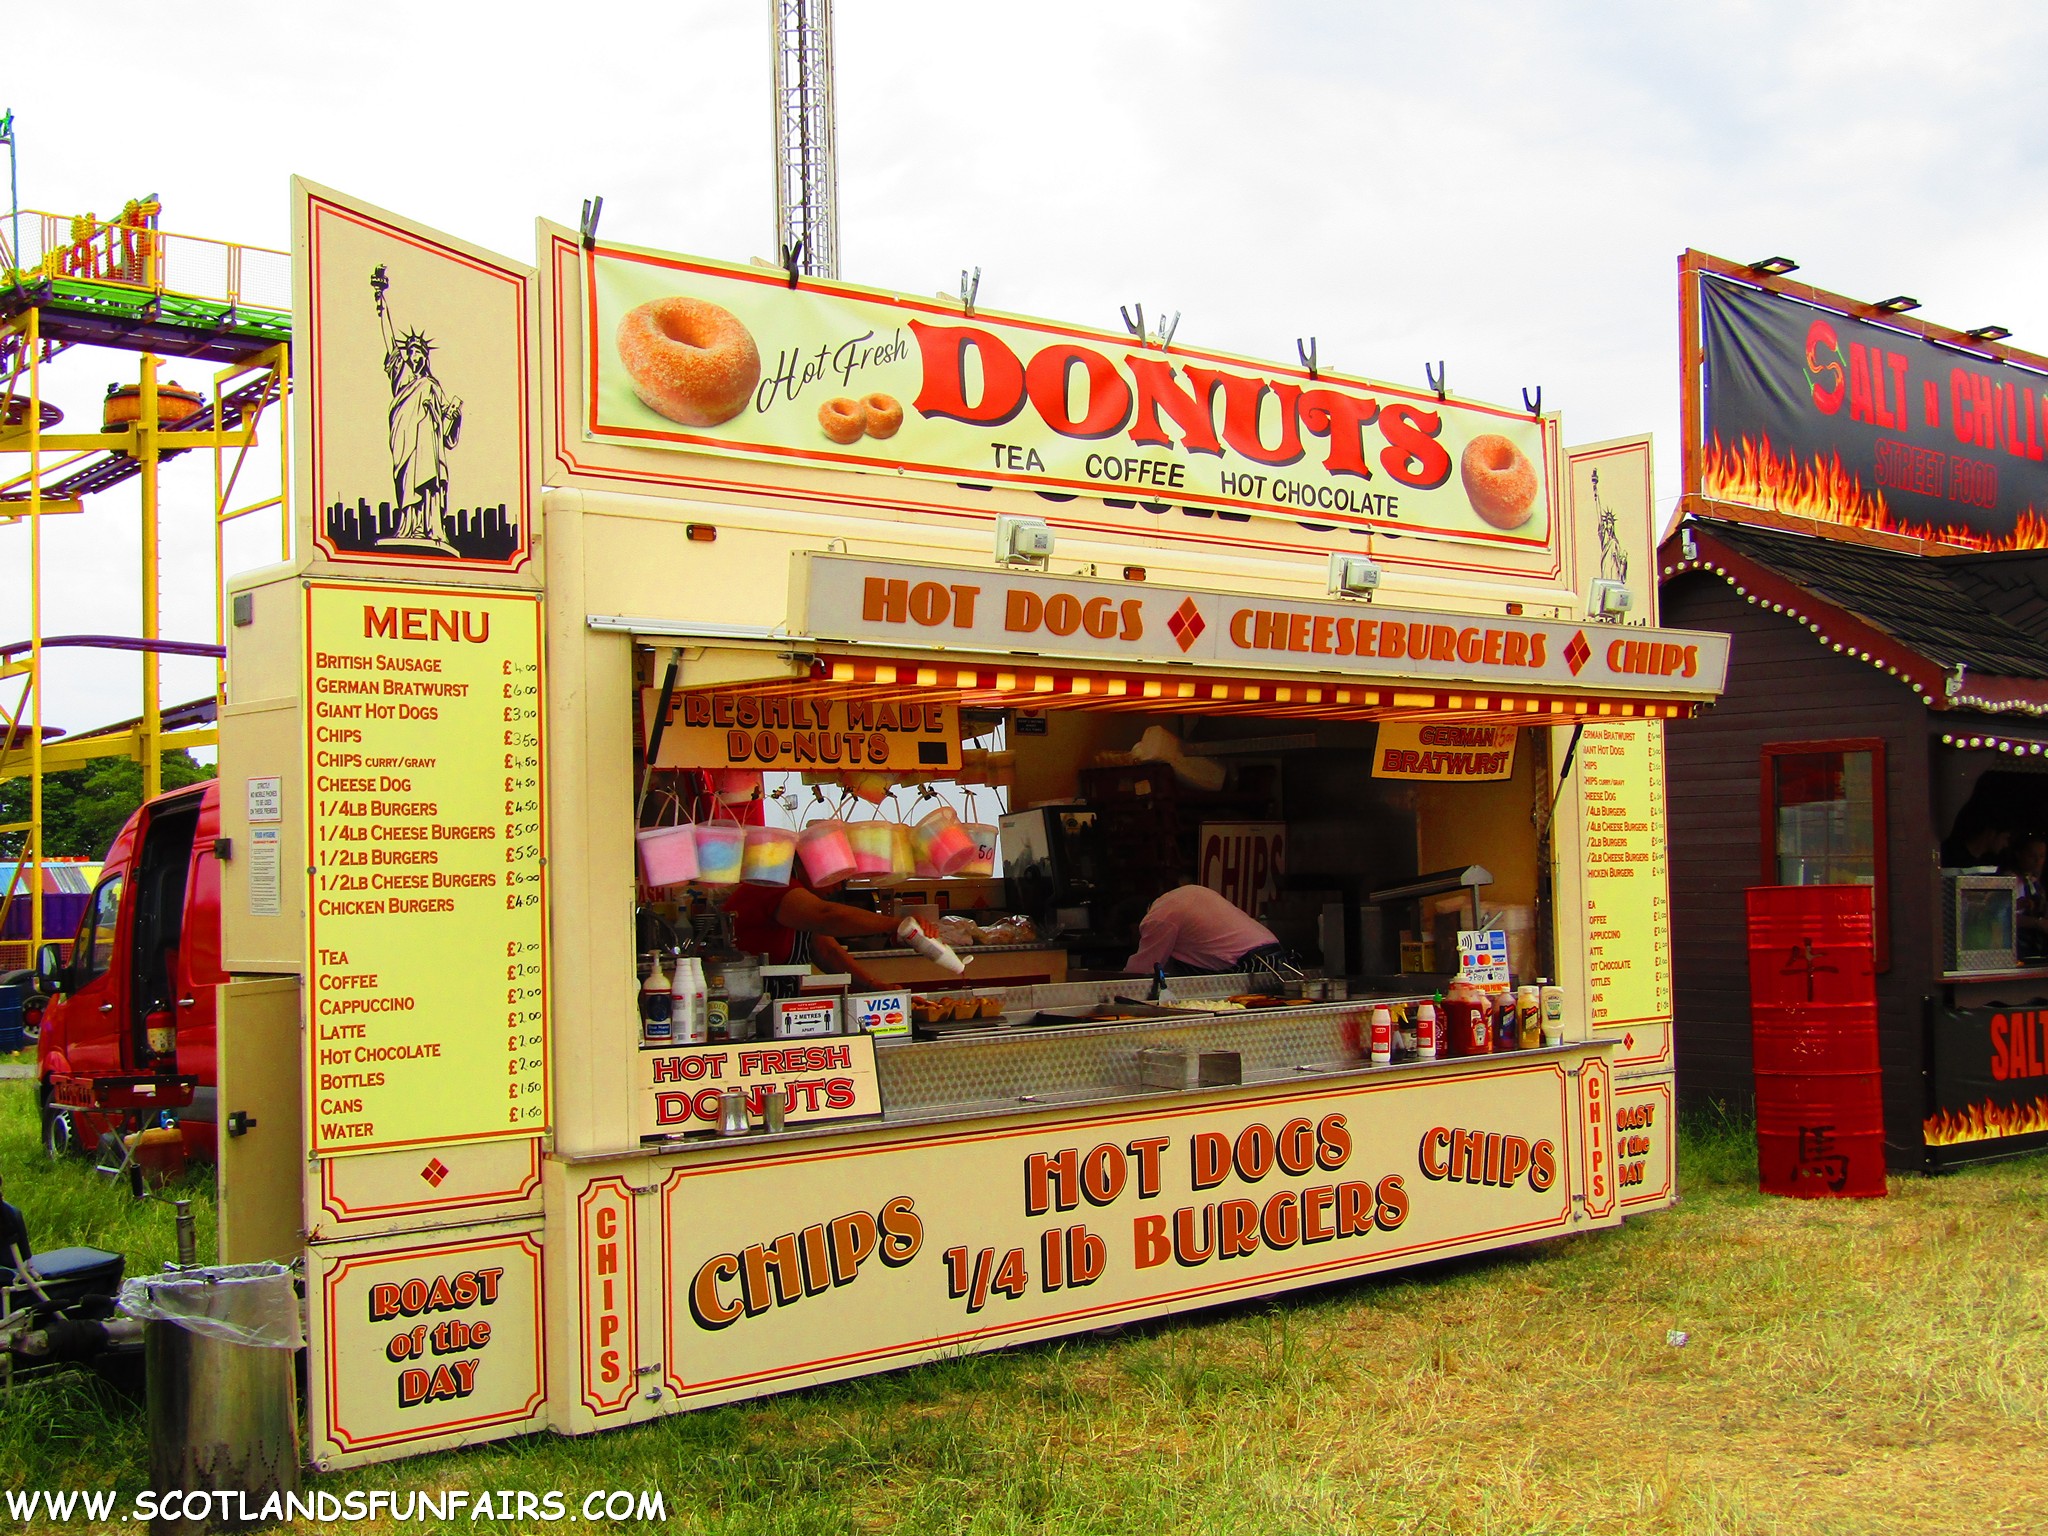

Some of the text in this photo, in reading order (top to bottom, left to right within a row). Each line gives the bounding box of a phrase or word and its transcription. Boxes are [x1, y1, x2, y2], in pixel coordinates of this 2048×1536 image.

[756, 328, 909, 414] Hot Fresh
[1803, 319, 1909, 433] SALT
[907, 318, 1453, 490] DONUTS
[990, 442, 1046, 473] TEA
[1085, 453, 1185, 488] COFFEE
[1220, 471, 1267, 497] HOT
[1272, 477, 1399, 518] CHOCOLATE
[1874, 438, 1998, 510] STREET FOOD
[364, 606, 489, 643] MENU
[862, 576, 1699, 679] HOT DOGS CHEESEBURGERS CHIPS
[316, 653, 372, 670] BRITISH
[376, 655, 441, 672] SAUSAGE
[316, 677, 379, 694] GERMAN
[383, 680, 468, 697] BRATWURST
[316, 702, 362, 718] GIANT
[365, 703, 395, 719] HOT
[399, 704, 438, 720] DOGS
[664, 694, 944, 733] FRESHLY MADE
[316, 726, 362, 742] CHIPS
[1418, 725, 1496, 747] GERMAN
[1583, 730, 1602, 739] ERMAN
[727, 729, 890, 764] DO-NUTS
[1583, 746, 1596, 754] IANT
[316, 752, 362, 767] CHIPS
[365, 757, 436, 768] CURRY/GRAVY
[1382, 748, 1509, 775] BRATWURST
[317, 777, 376, 791] CHEESE
[380, 777, 411, 791] DOG
[1586, 806, 1600, 816] /4LB
[1587, 822, 1601, 831] /4LB
[1587, 837, 1601, 847] /2LB
[1587, 852, 1602, 862] /2LB
[1203, 834, 1283, 918] CHIPS
[1588, 869, 1608, 878] HICKEN
[319, 900, 384, 915] CHICKEN
[389, 899, 454, 913] BURGERS
[1588, 901, 1596, 909] EA
[1589, 916, 1607, 924] OFFEE
[1590, 931, 1620, 940] APPUCCINO
[319, 950, 348, 965] TEA
[1590, 947, 1603, 955] ATTE
[320, 975, 377, 990] COFFEE
[1591, 978, 1611, 986] OTTLES
[320, 998, 414, 1015] CAPPUCCINO
[864, 998, 900, 1011] VISA
[1592, 994, 1603, 1002] ANS
[799, 1012, 822, 1020] METRES
[1592, 1008, 1607, 1018] ATER
[320, 1025, 365, 1040] LATTE
[320, 1049, 351, 1065] HOT
[355, 1044, 440, 1062] CHOCOLATE
[1990, 1010, 2048, 1081] SALT
[653, 1044, 852, 1083] HOT FRESH
[321, 1073, 384, 1090] BOTTLES
[321, 1099, 362, 1115] CANS
[655, 1077, 856, 1125] DONUTS
[1616, 1103, 1655, 1132] OAST
[321, 1123, 373, 1140] WATER
[1588, 1077, 1604, 1197] CHIPS
[1617, 1135, 1650, 1159] f the
[1025, 1112, 1353, 1217] HOT DOGS
[1418, 1126, 1557, 1192] CHIPS
[942, 1246, 1028, 1313] 1/4
[1133, 1173, 1411, 1270] BURGERS
[688, 1195, 924, 1332] CHIPS
[369, 1265, 503, 1324] ROAST
[596, 1207, 621, 1384] CHIPS
[386, 1317, 491, 1363] of the
[398, 1359, 481, 1408] DAY
